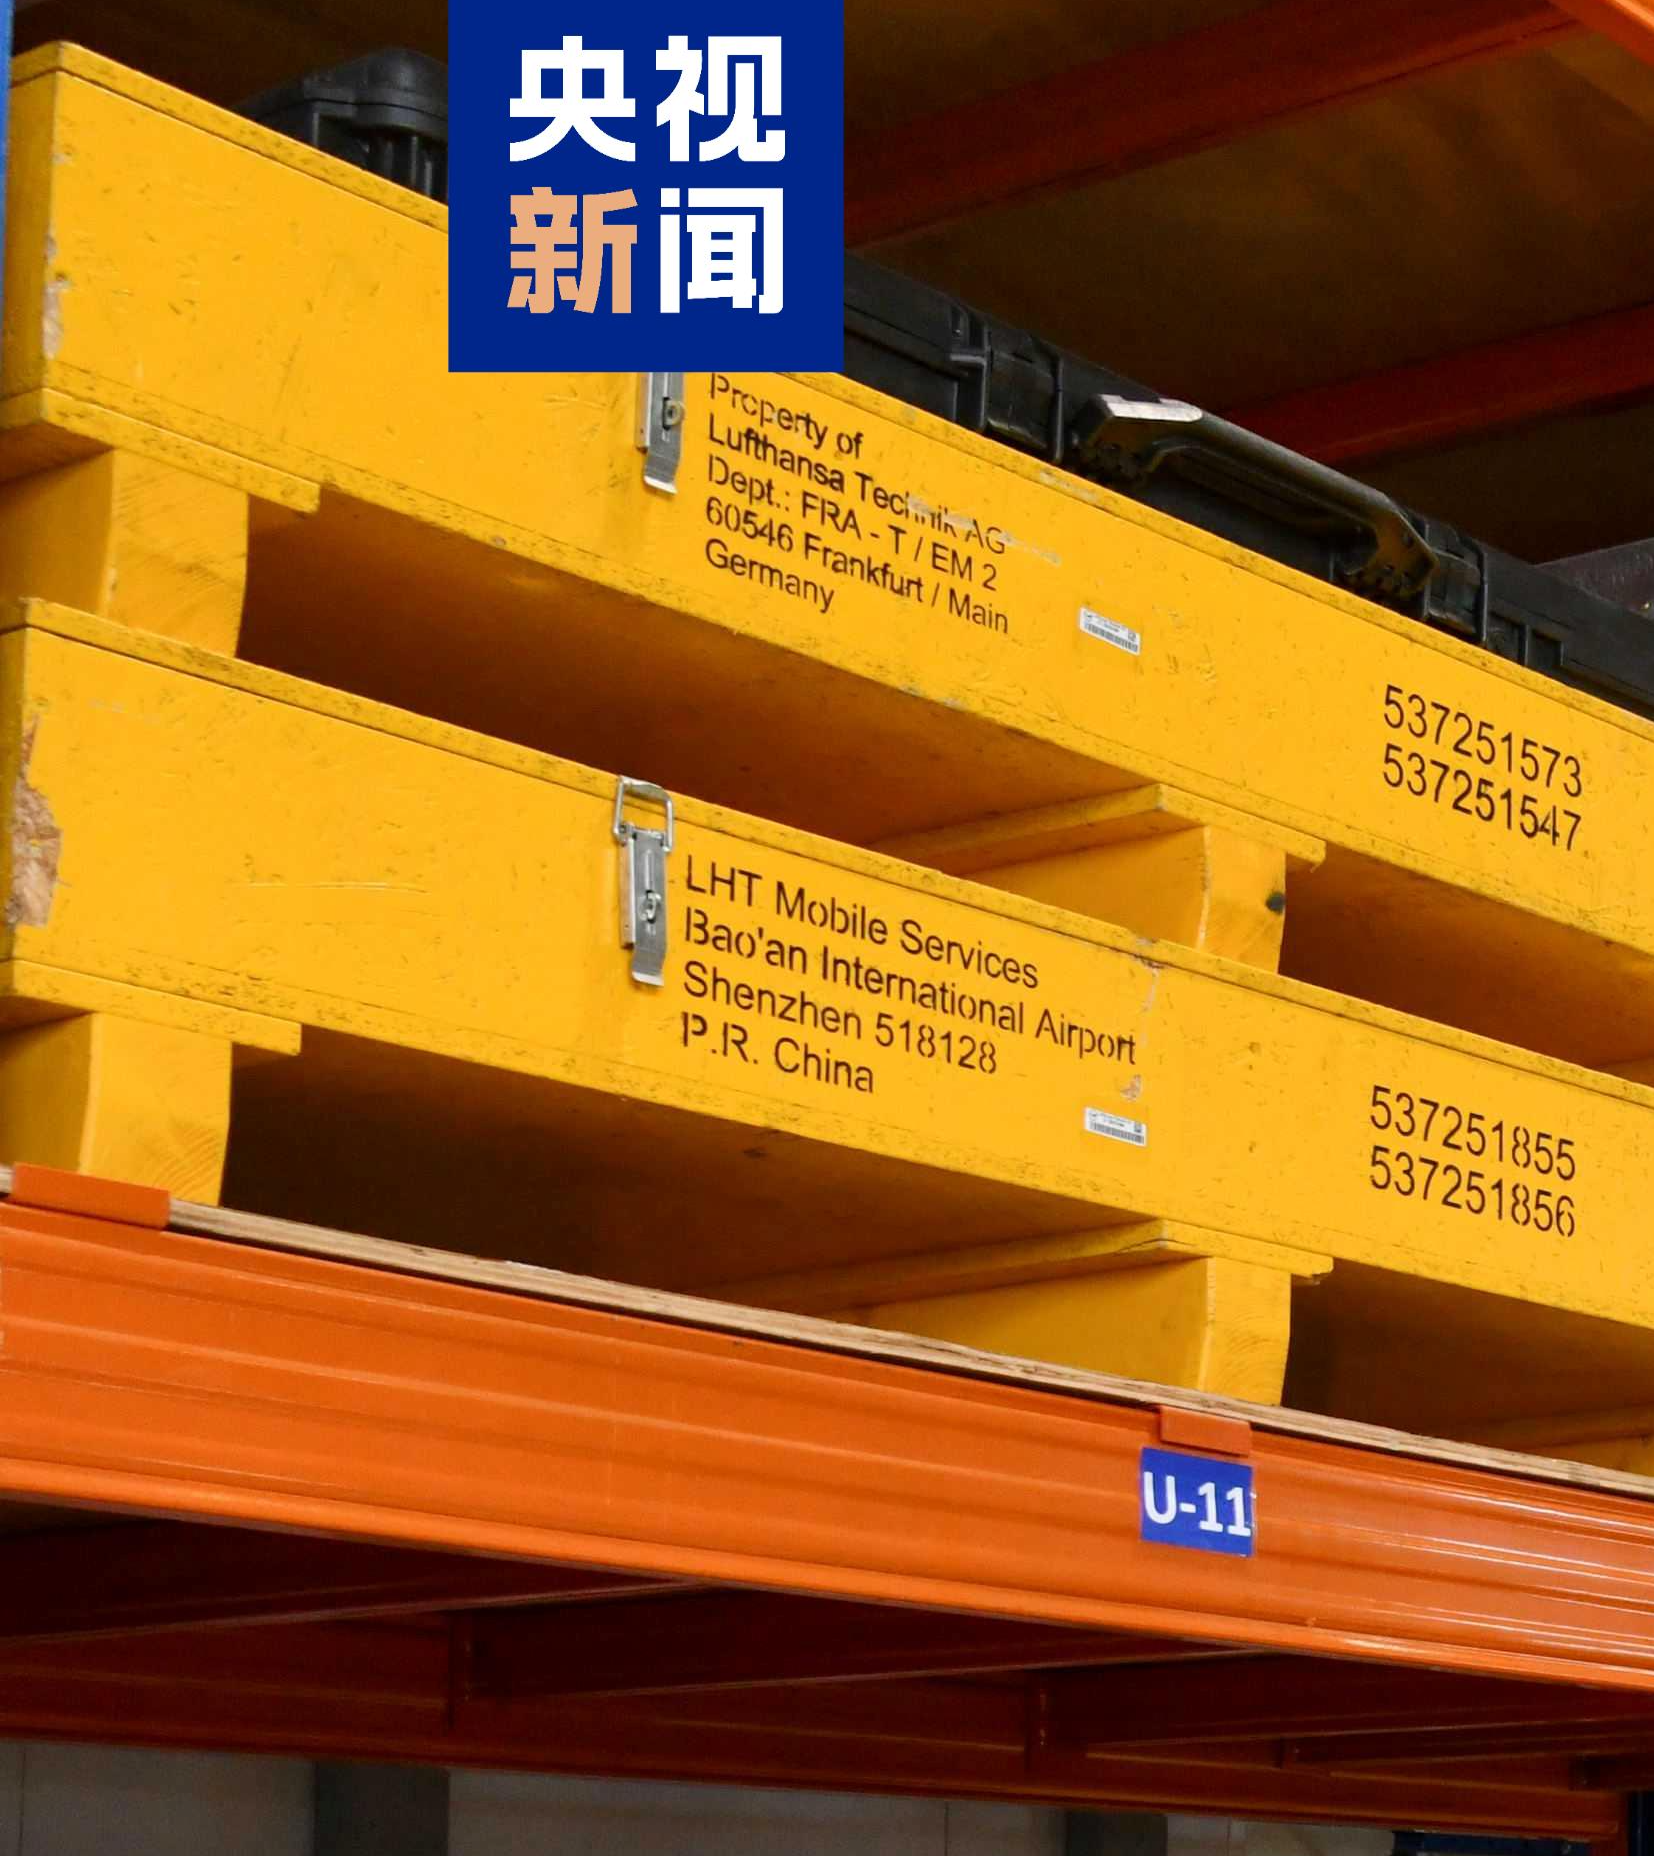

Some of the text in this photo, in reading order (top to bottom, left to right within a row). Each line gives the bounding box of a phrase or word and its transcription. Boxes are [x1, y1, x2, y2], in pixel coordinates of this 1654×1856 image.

[710, 372, 863, 459] Property of
[708, 413, 844, 493] Lufthansa
[965, 520, 1006, 554] AG
[709, 455, 790, 511] Dept.:
[802, 491, 861, 540] FRA
[888, 525, 906, 555] T
[914, 538, 923, 562] /
[932, 543, 973, 582] EM
[983, 564, 997, 591] 2
[705, 539, 835, 614] Germany
[706, 497, 1009, 634] 60546 Frankfurt / Main
[1383, 684, 1582, 798] 537251573
[1382, 745, 1581, 851] 537251547
[686, 854, 1038, 989] LHT Mobile Services
[683, 960, 997, 1074] Shenzhen 518128
[685, 907, 1136, 1065] Bao'an International Airport
[681, 1011, 874, 1093] P.R. China
[1369, 1084, 1576, 1182] 537251855
[1369, 1145, 1576, 1238] 537251856
[1143, 1471, 1252, 1537] U-11
